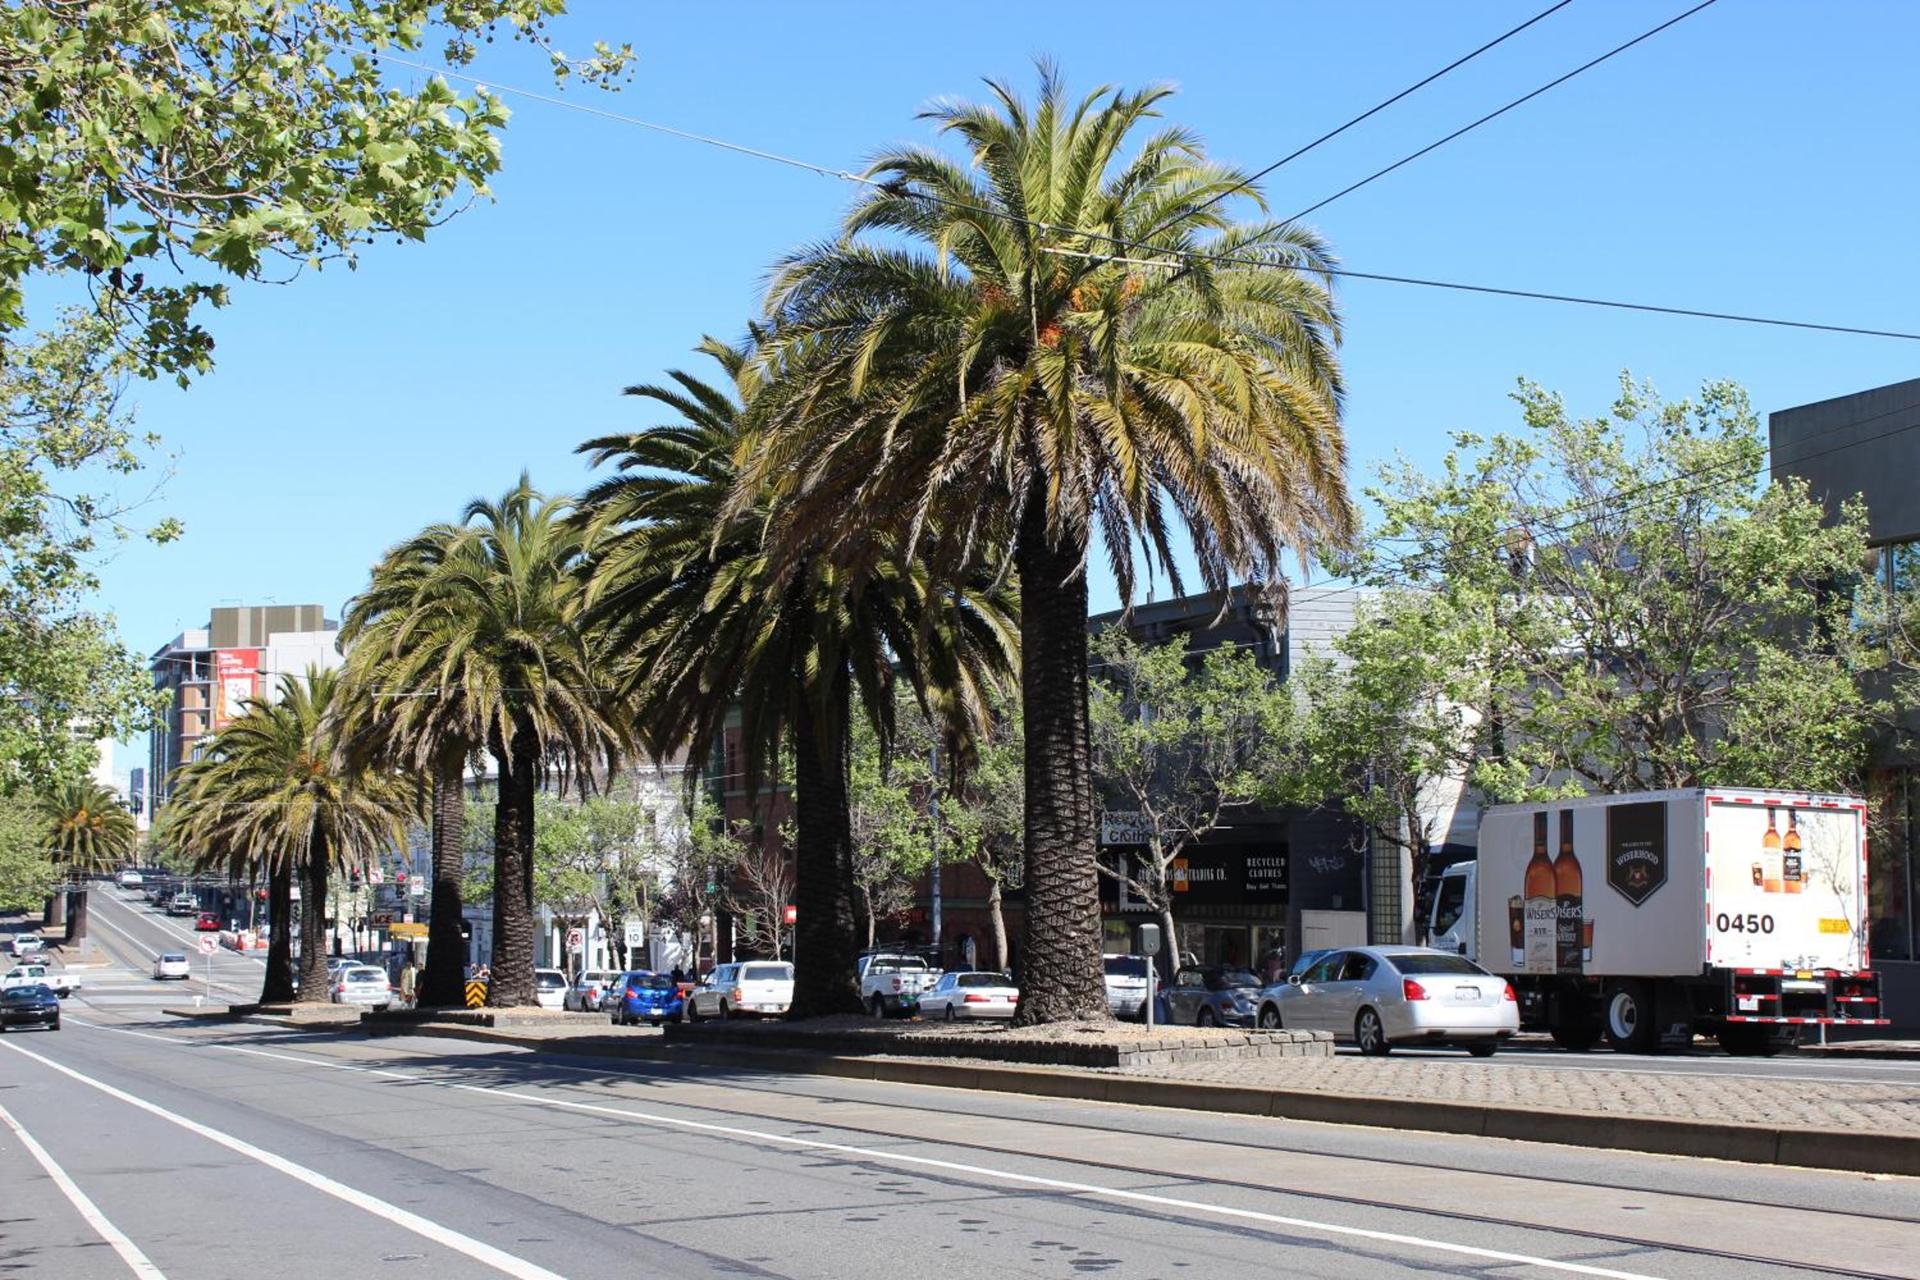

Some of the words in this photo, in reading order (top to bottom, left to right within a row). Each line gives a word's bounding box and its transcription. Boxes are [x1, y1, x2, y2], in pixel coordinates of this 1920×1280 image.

[1247, 857, 1285, 867] RECYCLED
[1616, 849, 1659, 866] WISERHOOD
[1248, 868, 1282, 878] CLOTHES
[1716, 913, 1774, 934] 0450
